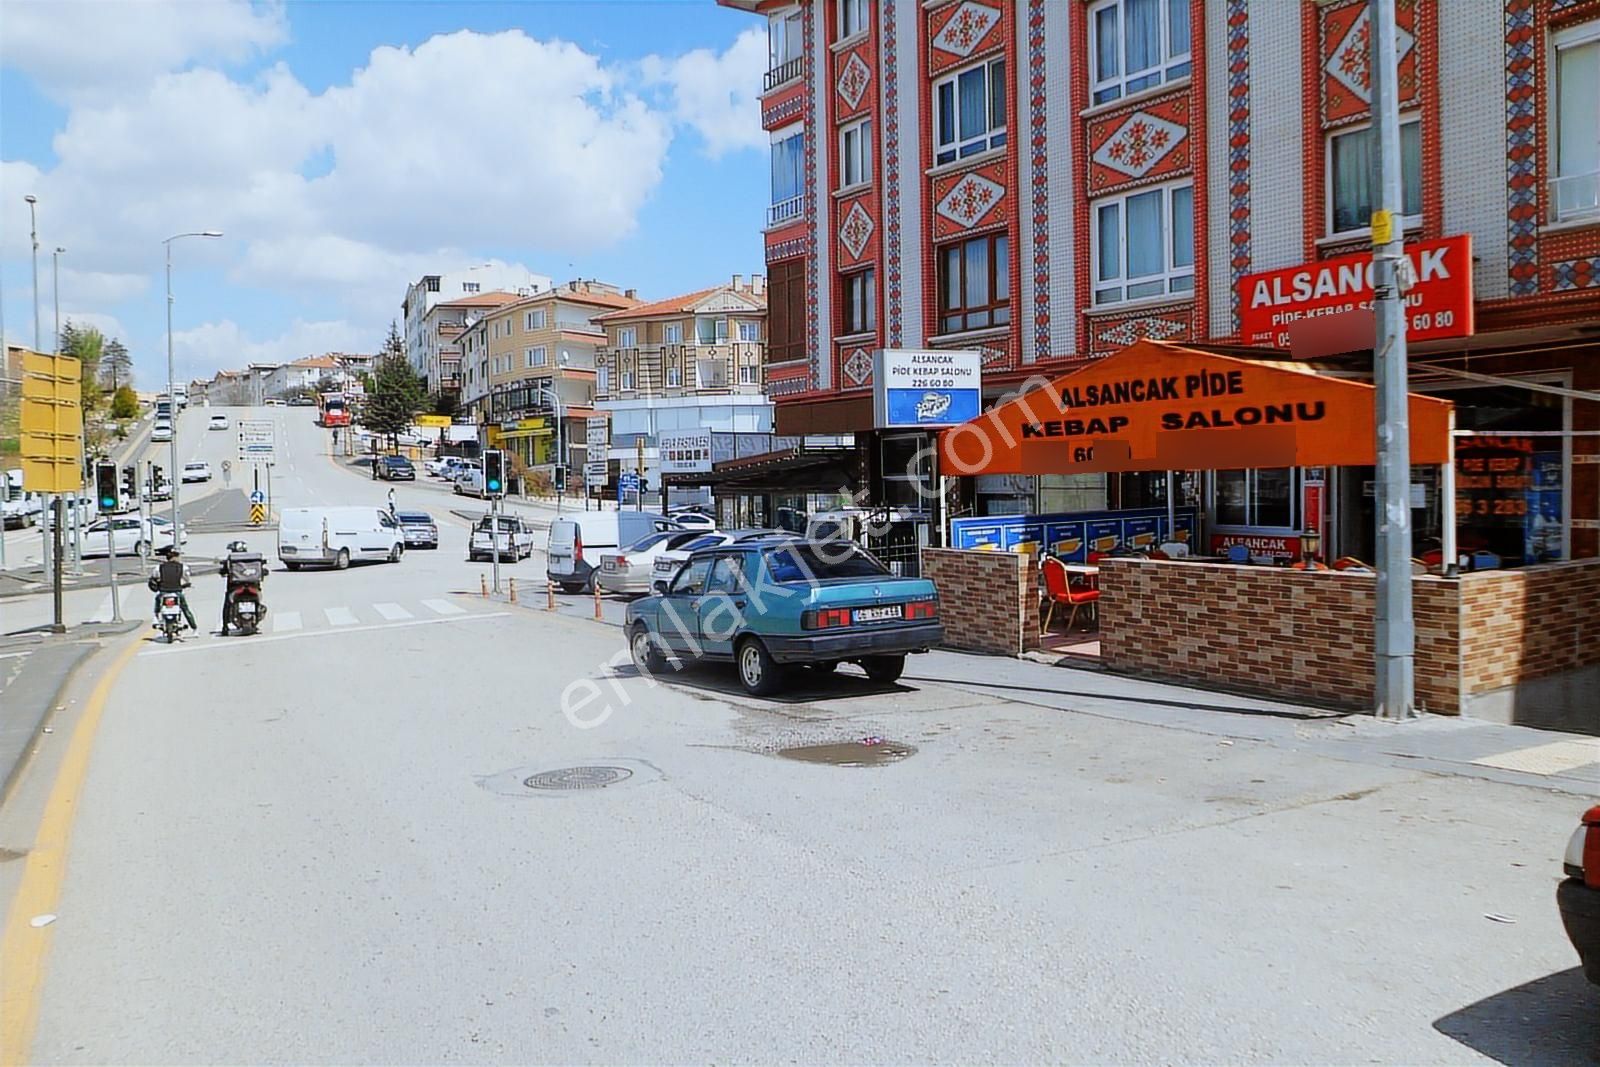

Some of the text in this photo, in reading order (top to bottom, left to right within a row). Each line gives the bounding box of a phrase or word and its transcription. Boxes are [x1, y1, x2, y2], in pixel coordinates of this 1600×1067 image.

[1413, 315, 1431, 331] 60
[1435, 310, 1454, 328] 80
[912, 355, 953, 364] ALSANCAK
[912, 367, 938, 376] KEBAP
[940, 367, 973, 376] SALONU
[1059, 368, 1244, 409] ALSANCAK PİDE
[1021, 401, 1326, 439] KEBAP SALONU
